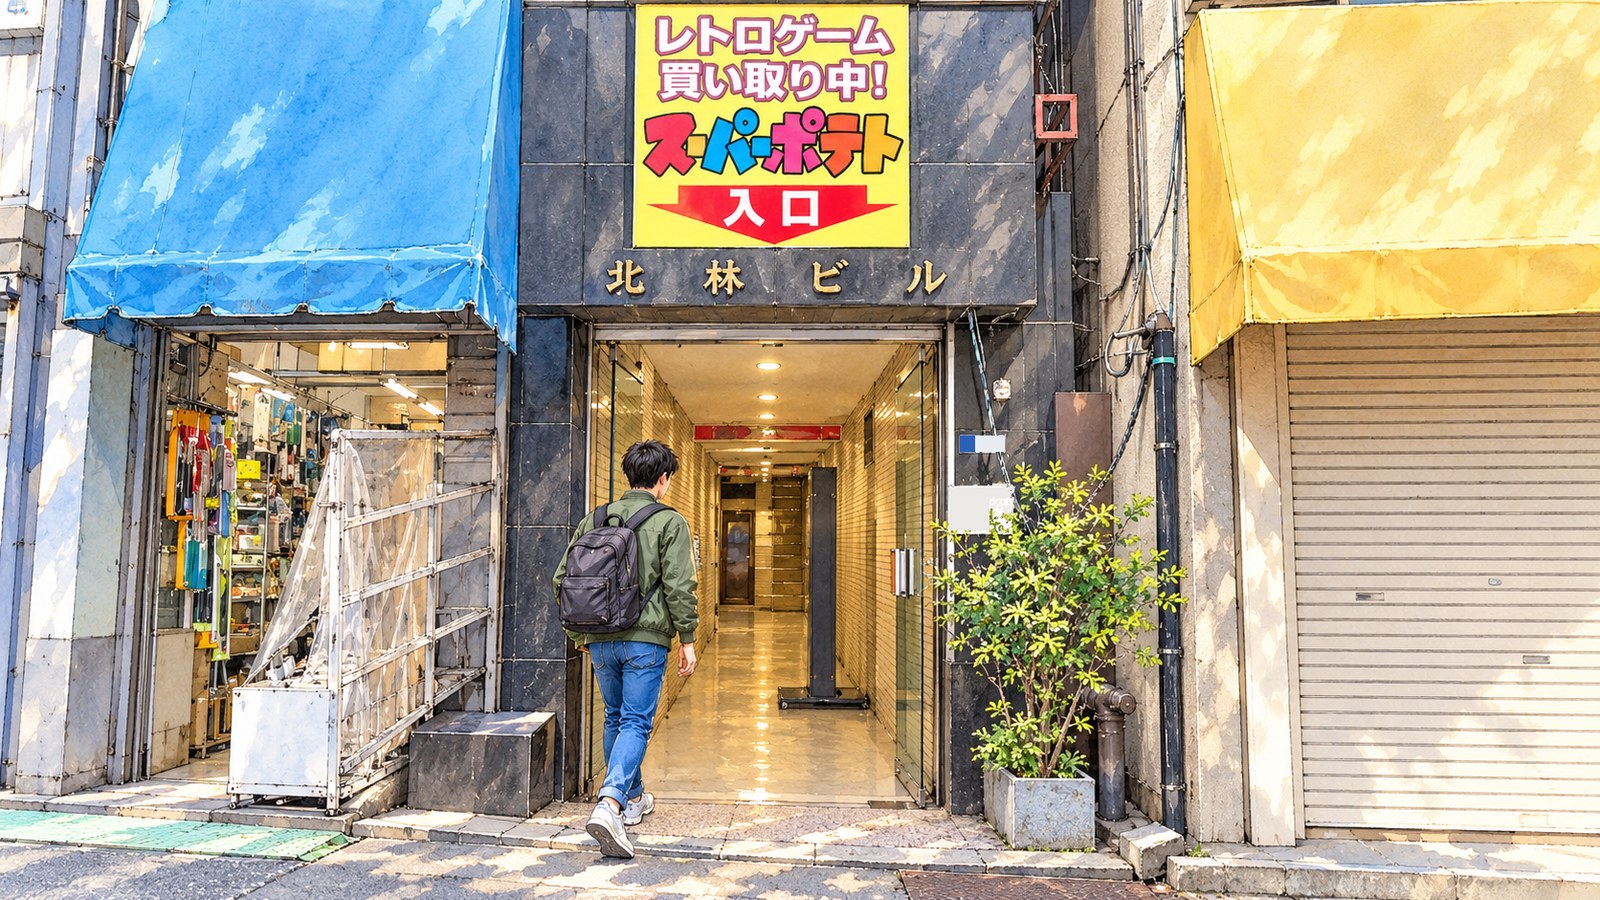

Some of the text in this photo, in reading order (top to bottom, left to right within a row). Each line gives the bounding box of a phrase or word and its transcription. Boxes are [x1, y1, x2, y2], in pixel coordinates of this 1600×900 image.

[656, 14, 894, 55] レトロゲーム
[658, 60, 887, 101] 買い取り中!
[644, 107, 903, 177] スーパーポテト
[724, 189, 819, 227] 入口
[606, 259, 947, 295] 北林ビル
